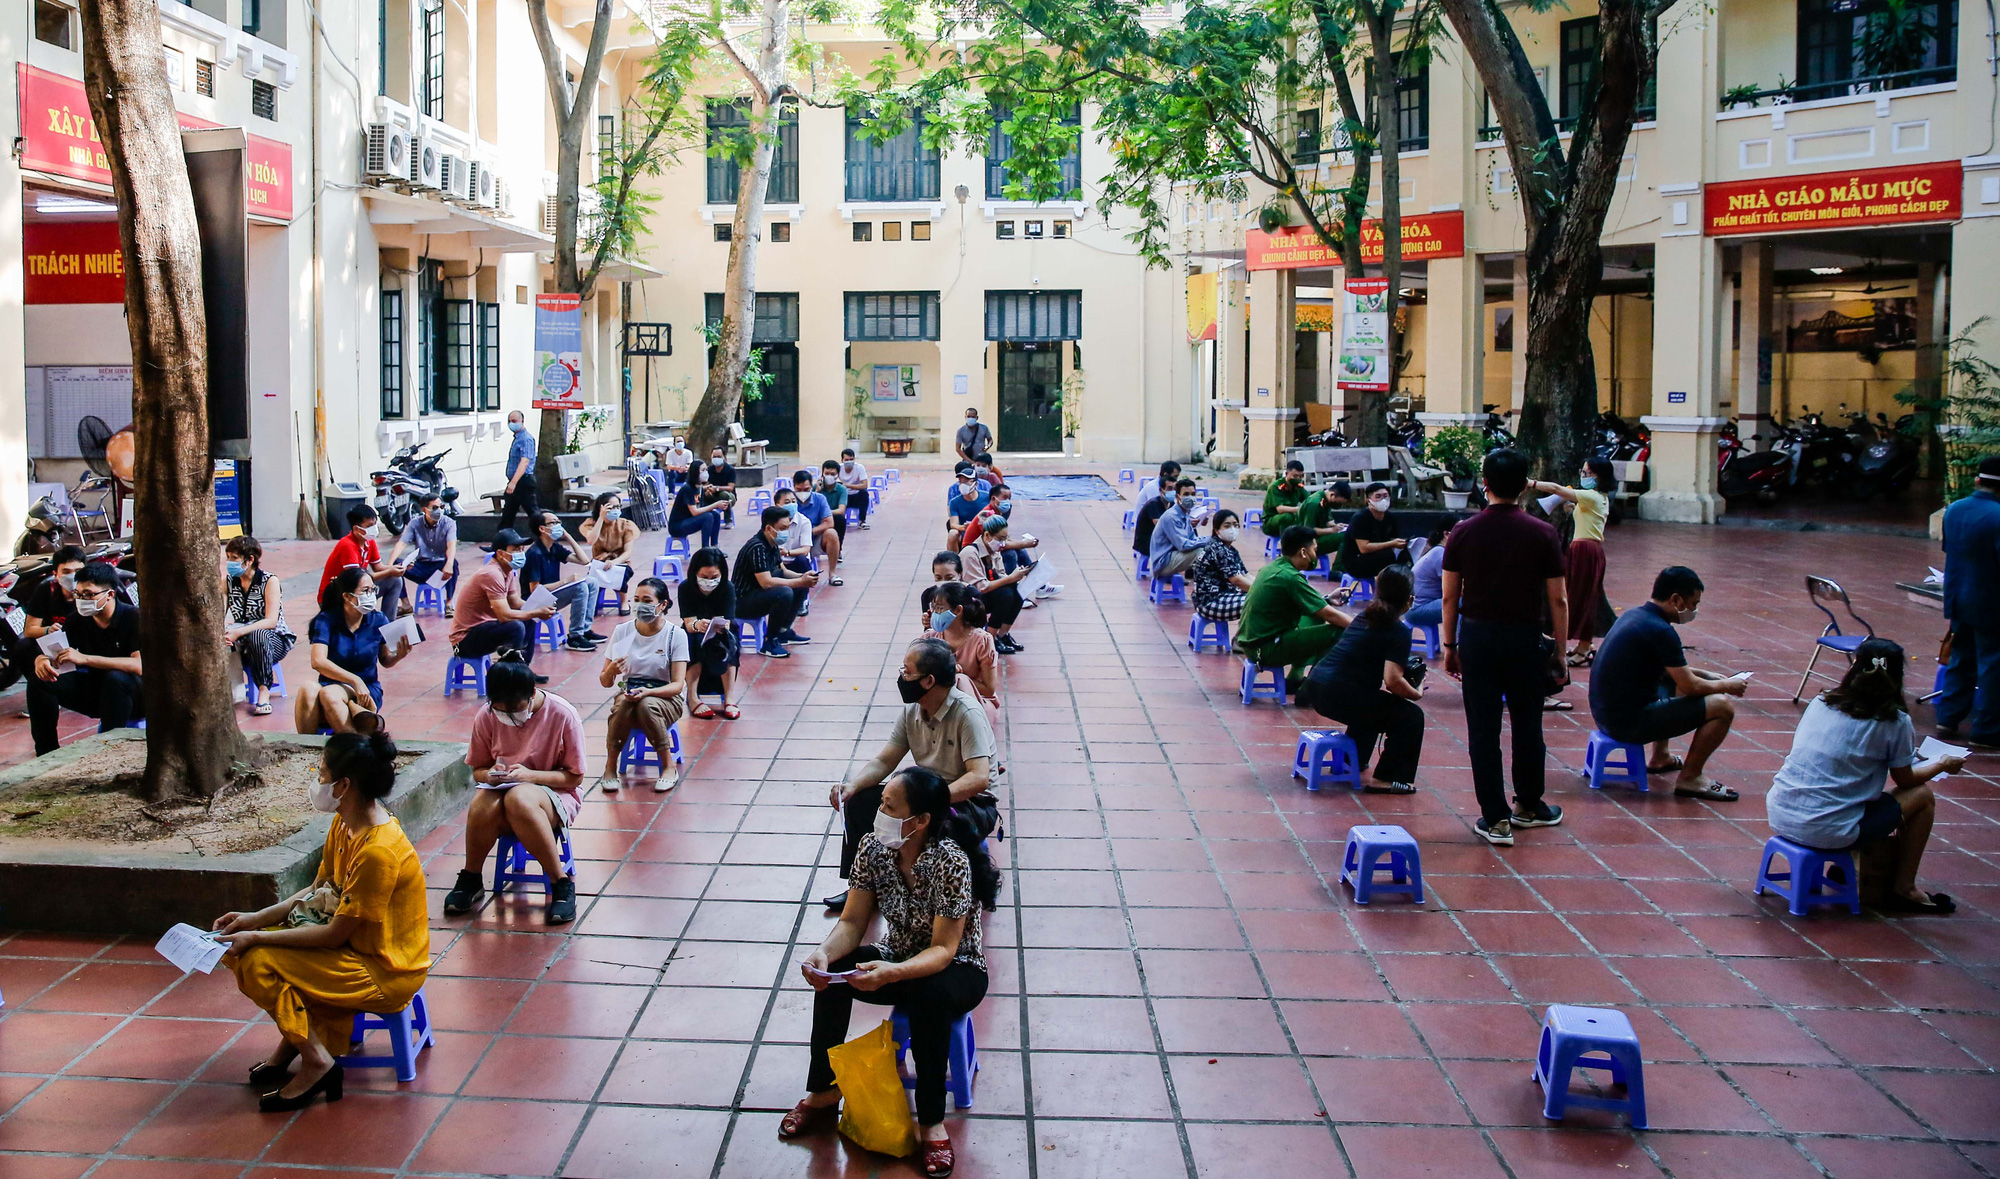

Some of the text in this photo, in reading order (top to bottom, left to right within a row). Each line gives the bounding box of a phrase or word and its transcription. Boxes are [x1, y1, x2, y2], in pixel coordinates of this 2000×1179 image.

[48, 105, 85, 139] XÂY
[69, 146, 111, 171] NHÀ GI
[255, 160, 279, 187] HÓA
[250, 187, 268, 205] LỊCH
[1728, 177, 1932, 211] NHÀ GIÁO MẪU MỰC
[1781, 208, 1817, 223] CHUYÊN
[1818, 206, 1840, 220] MÔN
[1865, 203, 1899, 217] PHONG
[1900, 200, 1927, 214] CÁCH
[1269, 233, 1299, 249] NHÀ
[1400, 222, 1432, 239] HÓA
[27, 249, 125, 279] TRÁCH NHIỆ
[1261, 252, 1286, 264] KHUNG
[1359, 243, 1372, 257] ỐT,
[1373, 244, 1384, 256] CH
[1400, 241, 1423, 256] ƯỢNG
[1424, 240, 1442, 252] CAO
